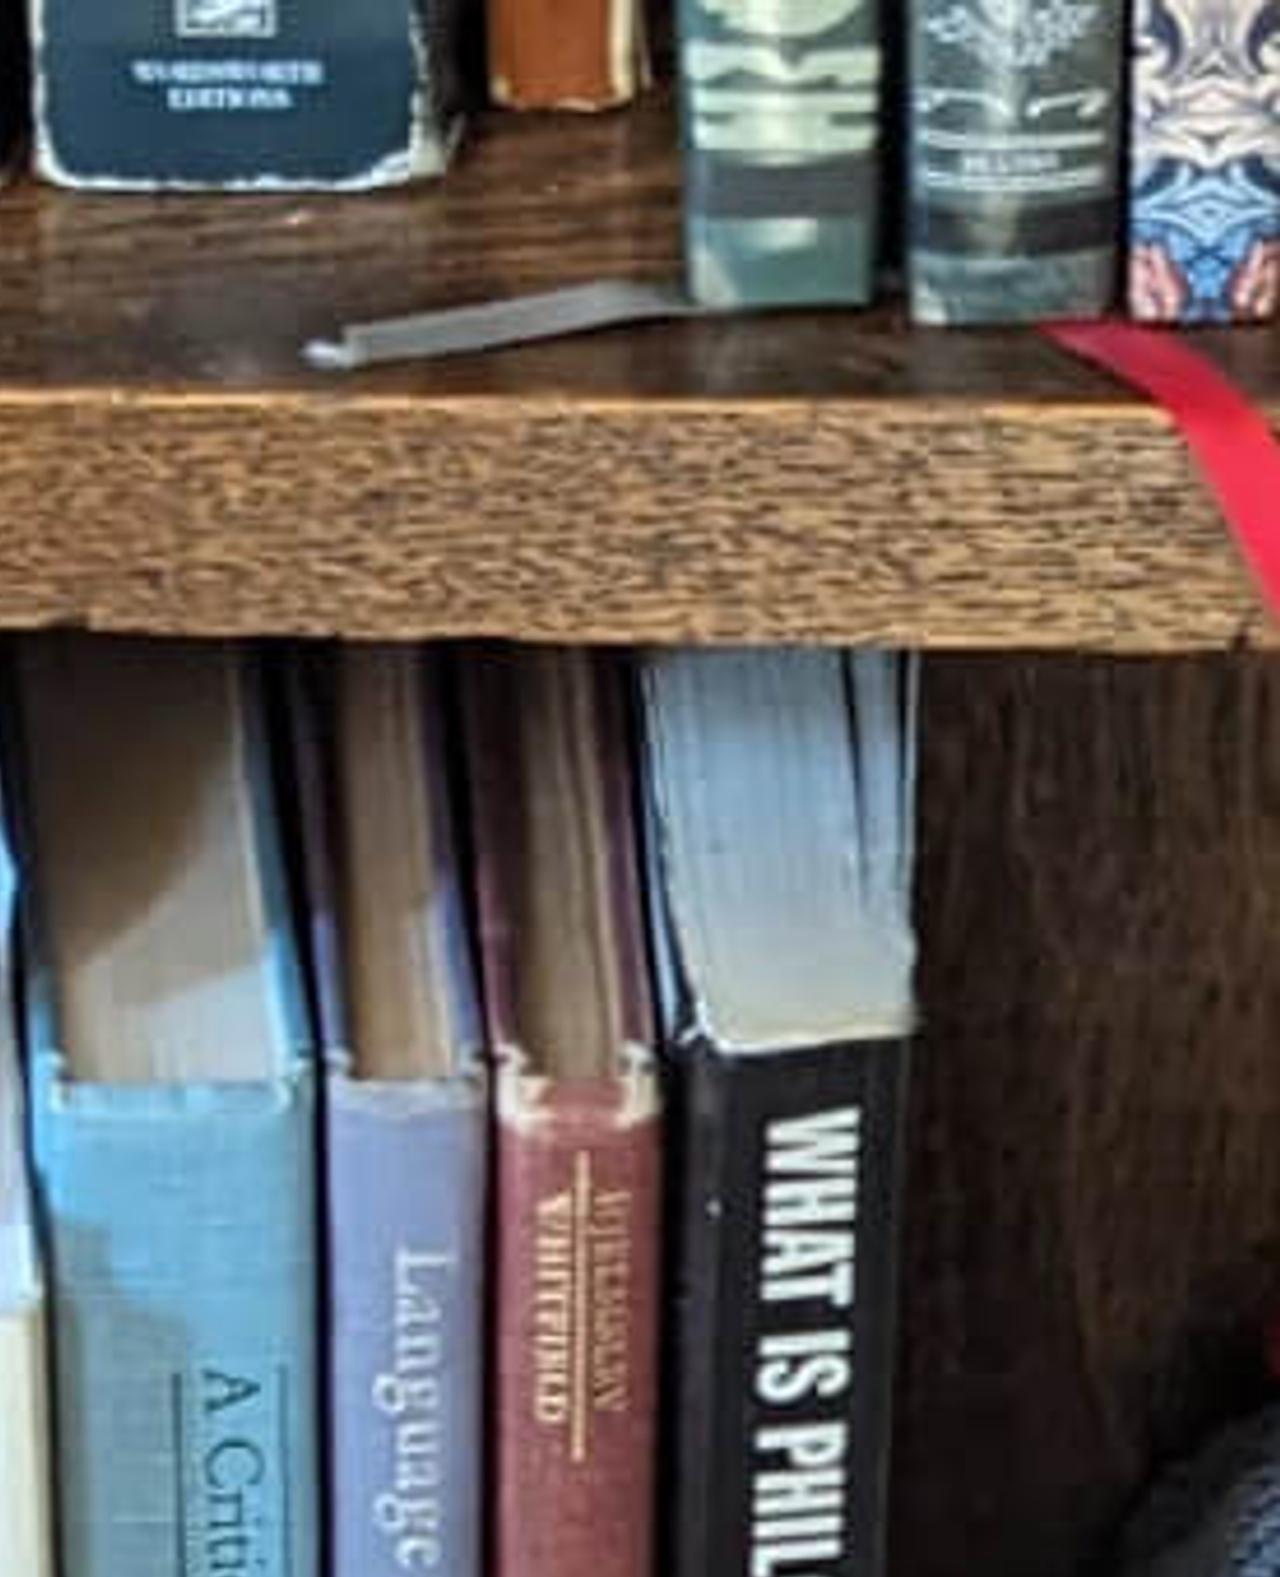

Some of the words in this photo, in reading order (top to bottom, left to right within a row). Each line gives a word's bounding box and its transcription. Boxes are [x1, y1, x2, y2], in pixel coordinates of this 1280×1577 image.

[131, 59, 324, 85] WORDSWORTH
[166, 86, 294, 111] EDITIONS
[757, 1106, 864, 1308] WHAT
[533, 1190, 572, 1427] WHITFIELD
[201, 1367, 260, 1418] A
[756, 1329, 853, 1404] IS
[373, 1243, 454, 1571] Language
